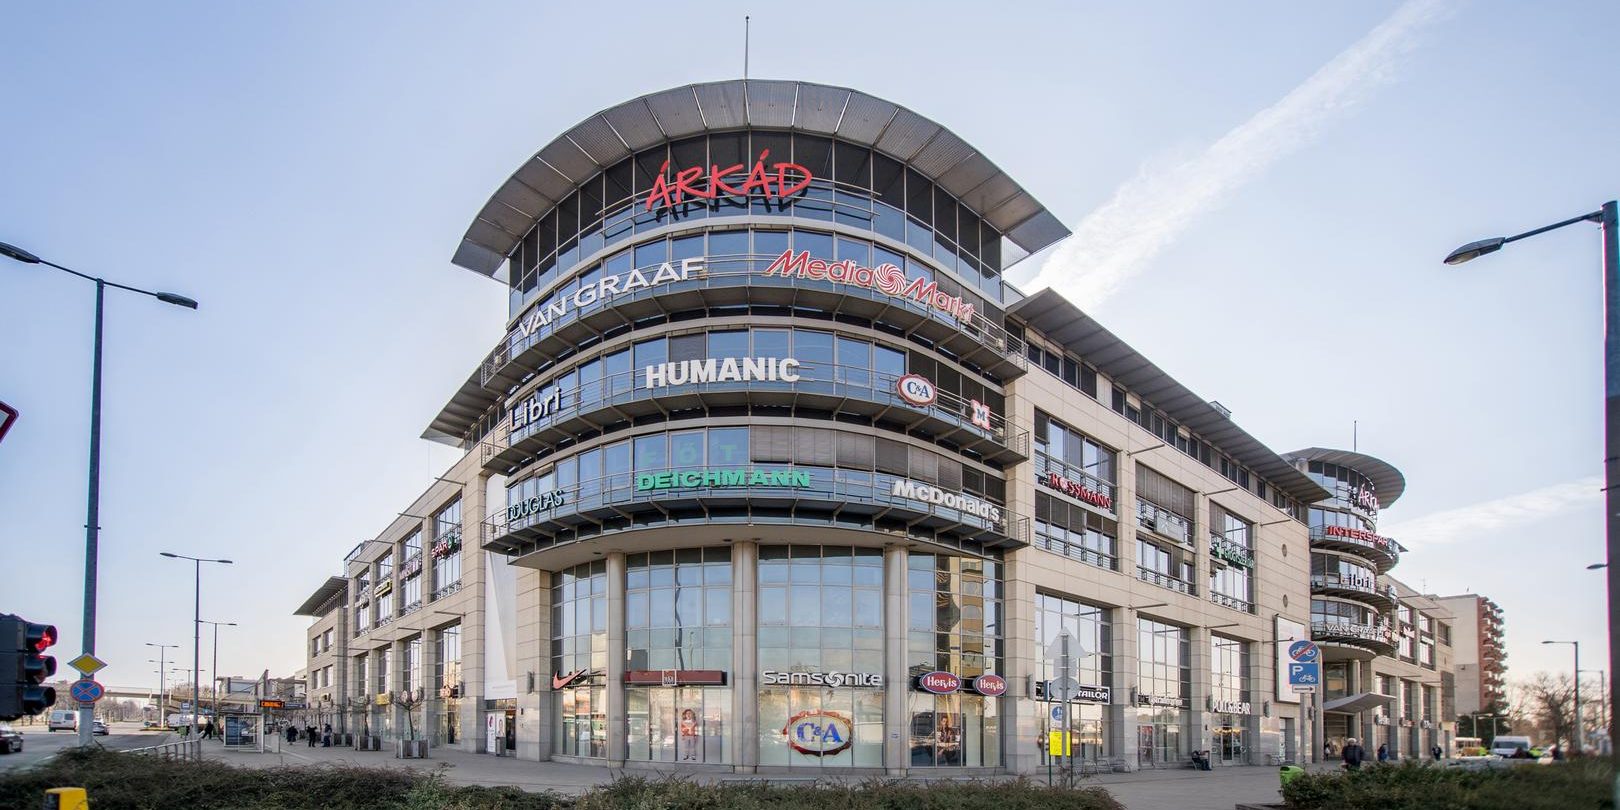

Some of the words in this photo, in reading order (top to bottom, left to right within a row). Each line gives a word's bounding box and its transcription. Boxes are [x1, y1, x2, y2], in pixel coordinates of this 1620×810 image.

[645, 148, 812, 212] ÁRKÁD
[519, 297, 567, 338] VAN
[574, 257, 705, 307] GRAAF
[762, 249, 875, 288] Media
[903, 276, 975, 324] Markt
[645, 357, 800, 389] HUMANIC
[907, 381, 930, 399] C&A
[509, 387, 562, 432] Libri
[636, 468, 811, 491] DEICHMANN
[1049, 471, 1111, 509] ROSSMANN
[507, 490, 564, 522] DOUGLAS
[892, 480, 1000, 522] McDonald's
[1328, 525, 1388, 546] INTERSPAR
[1339, 573, 1370, 588] Libri
[762, 671, 883, 687] Samsonite
[1292, 665, 1304, 676] P
[927, 677, 957, 689] Hervis
[980, 680, 1004, 691] Hervis
[1212, 700, 1251, 715] PULL&BEAR
[796, 722, 843, 743] C&A
